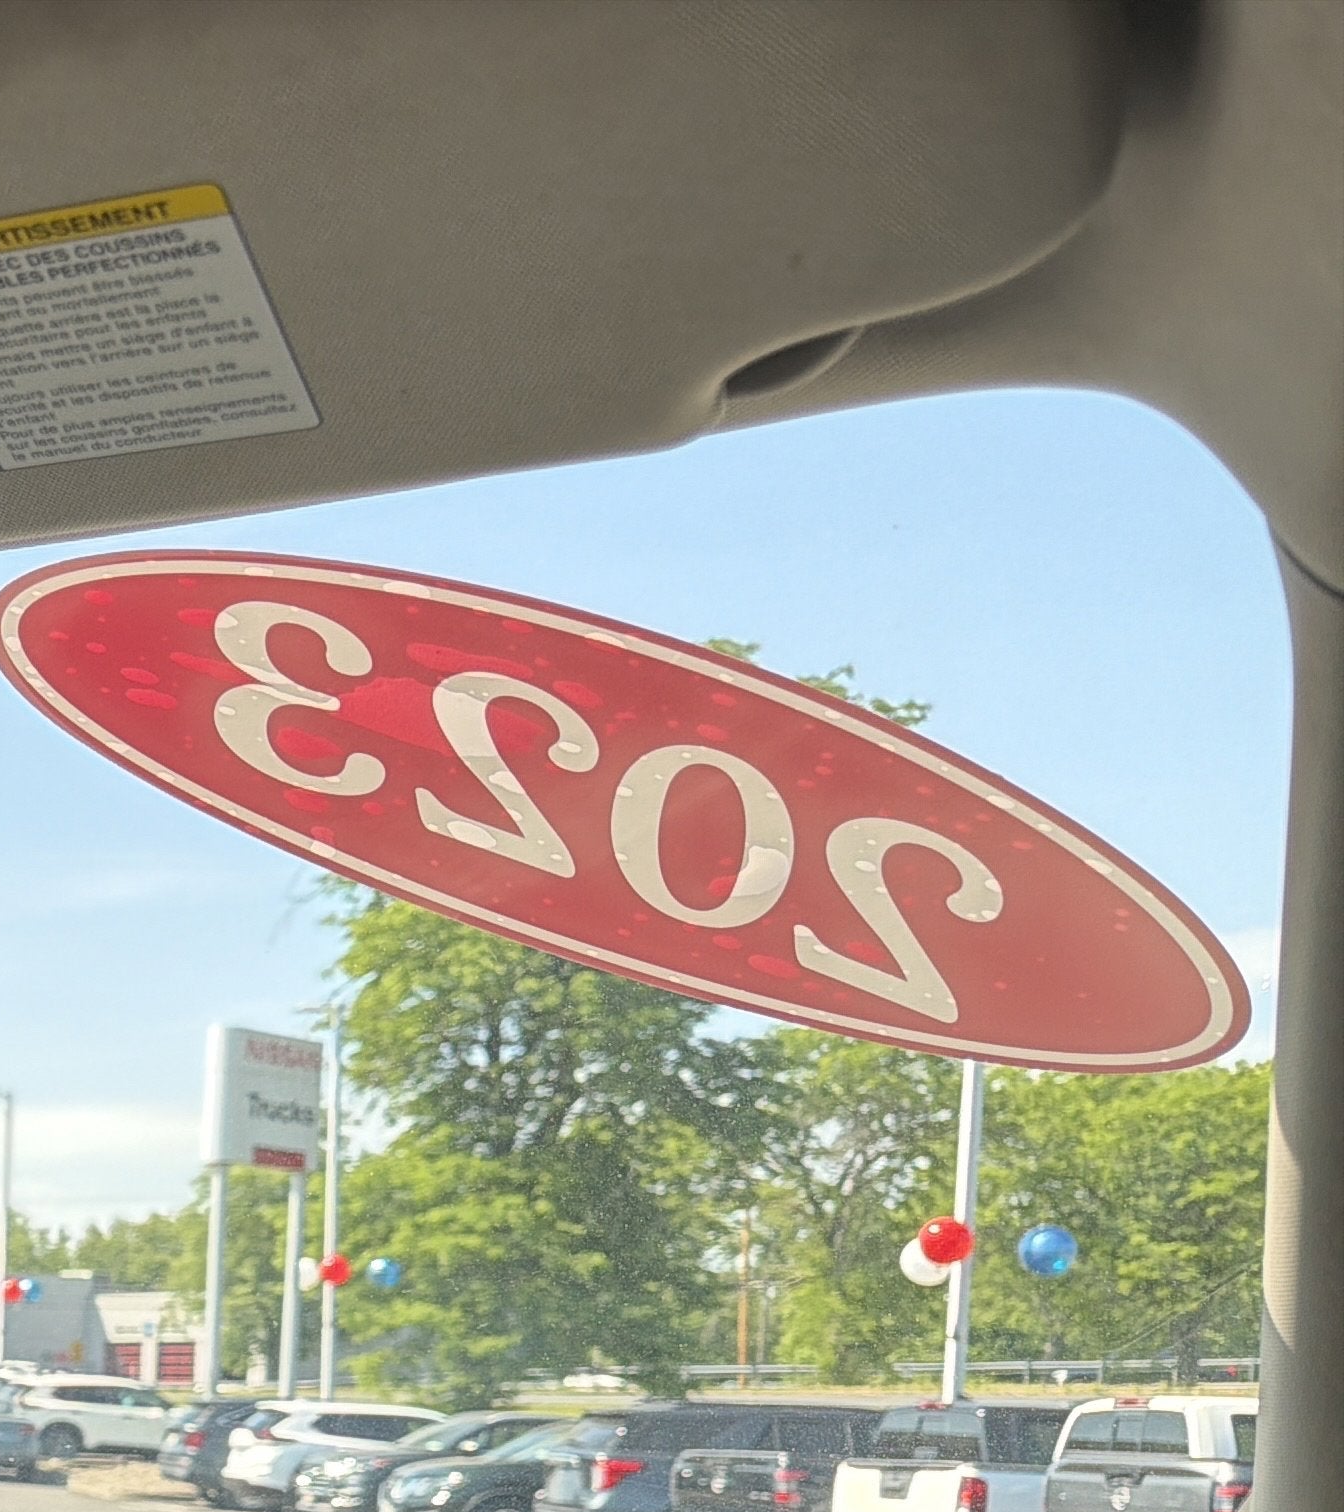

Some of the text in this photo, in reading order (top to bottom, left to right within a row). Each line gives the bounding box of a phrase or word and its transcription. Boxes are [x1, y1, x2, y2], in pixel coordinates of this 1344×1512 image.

[24, 248, 69, 267] DES
[72, 228, 187, 259] COUSSINS
[46, 241, 221, 281] PERFECTIONNÉS
